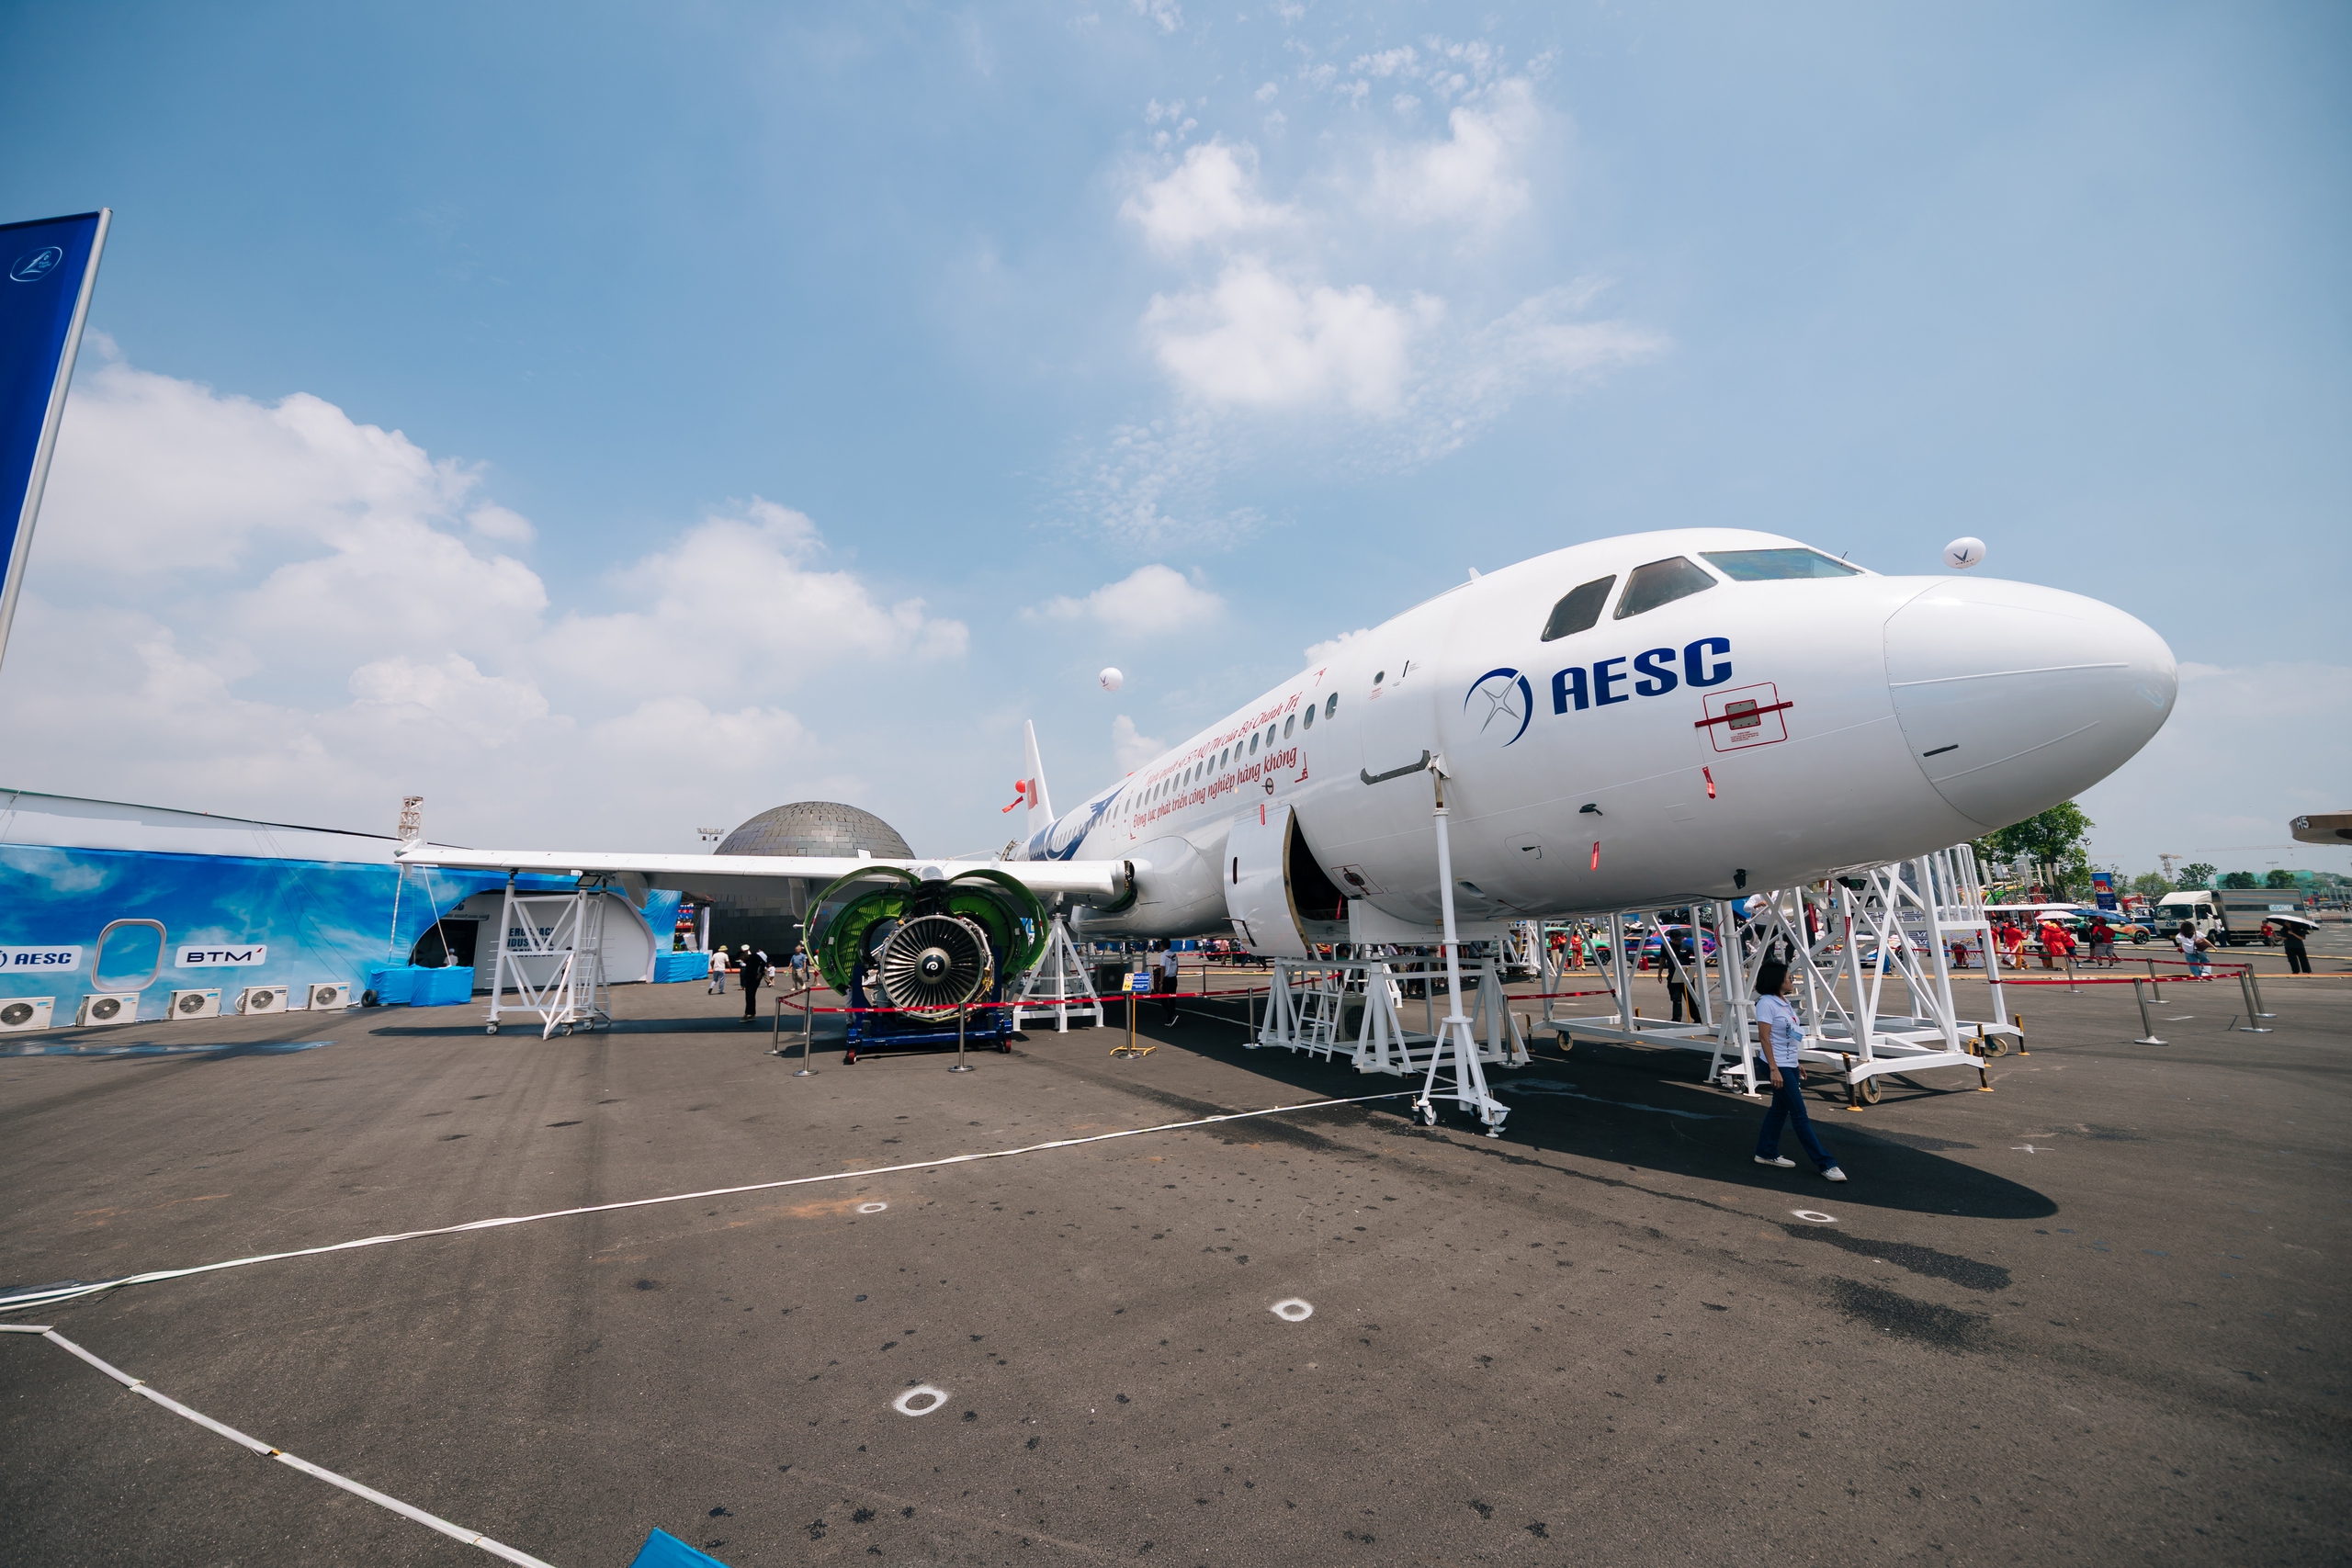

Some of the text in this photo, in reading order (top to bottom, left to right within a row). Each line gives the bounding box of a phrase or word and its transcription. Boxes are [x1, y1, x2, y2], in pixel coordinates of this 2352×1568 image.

[1551, 637, 1733, 716] AESC
[1238, 717, 1255, 738] Bộ
[1252, 703, 1283, 729] Chính
[1283, 691, 1303, 713] Trị
[1133, 747, 1297, 829] Động lực phát triển công nghiệp hàng không
[2296, 817, 2310, 830] H5
[15, 953, 72, 964] AESC
[187, 951, 253, 963] BTM
